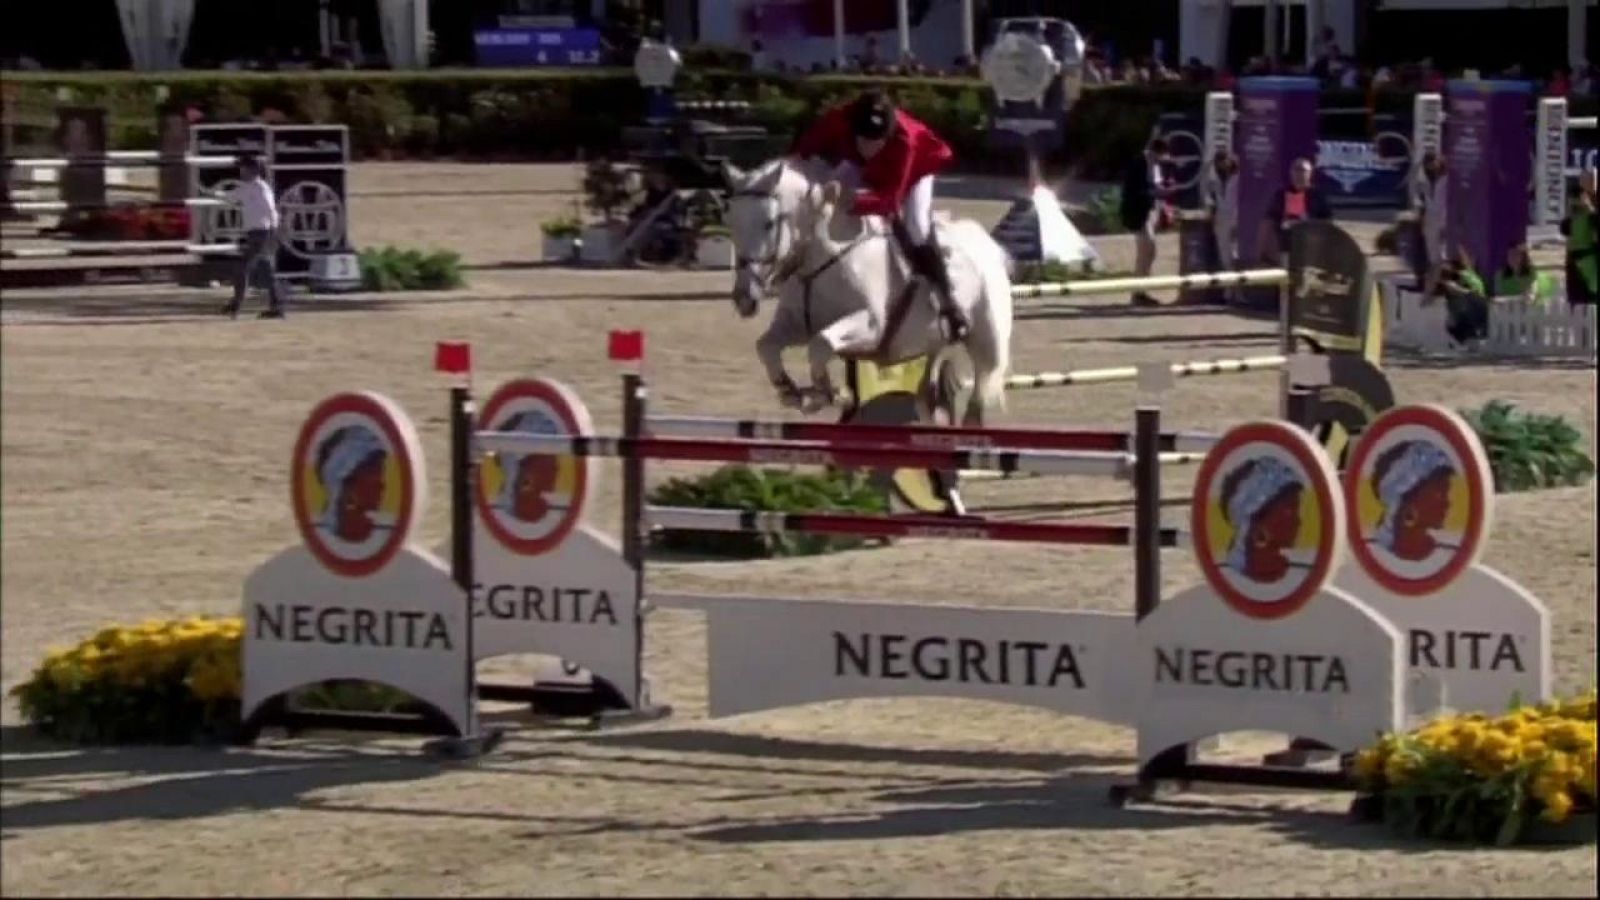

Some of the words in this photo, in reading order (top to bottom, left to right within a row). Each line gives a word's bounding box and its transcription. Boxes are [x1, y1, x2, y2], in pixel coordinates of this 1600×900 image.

[255, 603, 453, 650] NEGRITA
[832, 631, 1085, 688] NEGRITA
[1154, 647, 1349, 693] NEGRITA
[1408, 629, 1525, 672] RITA
